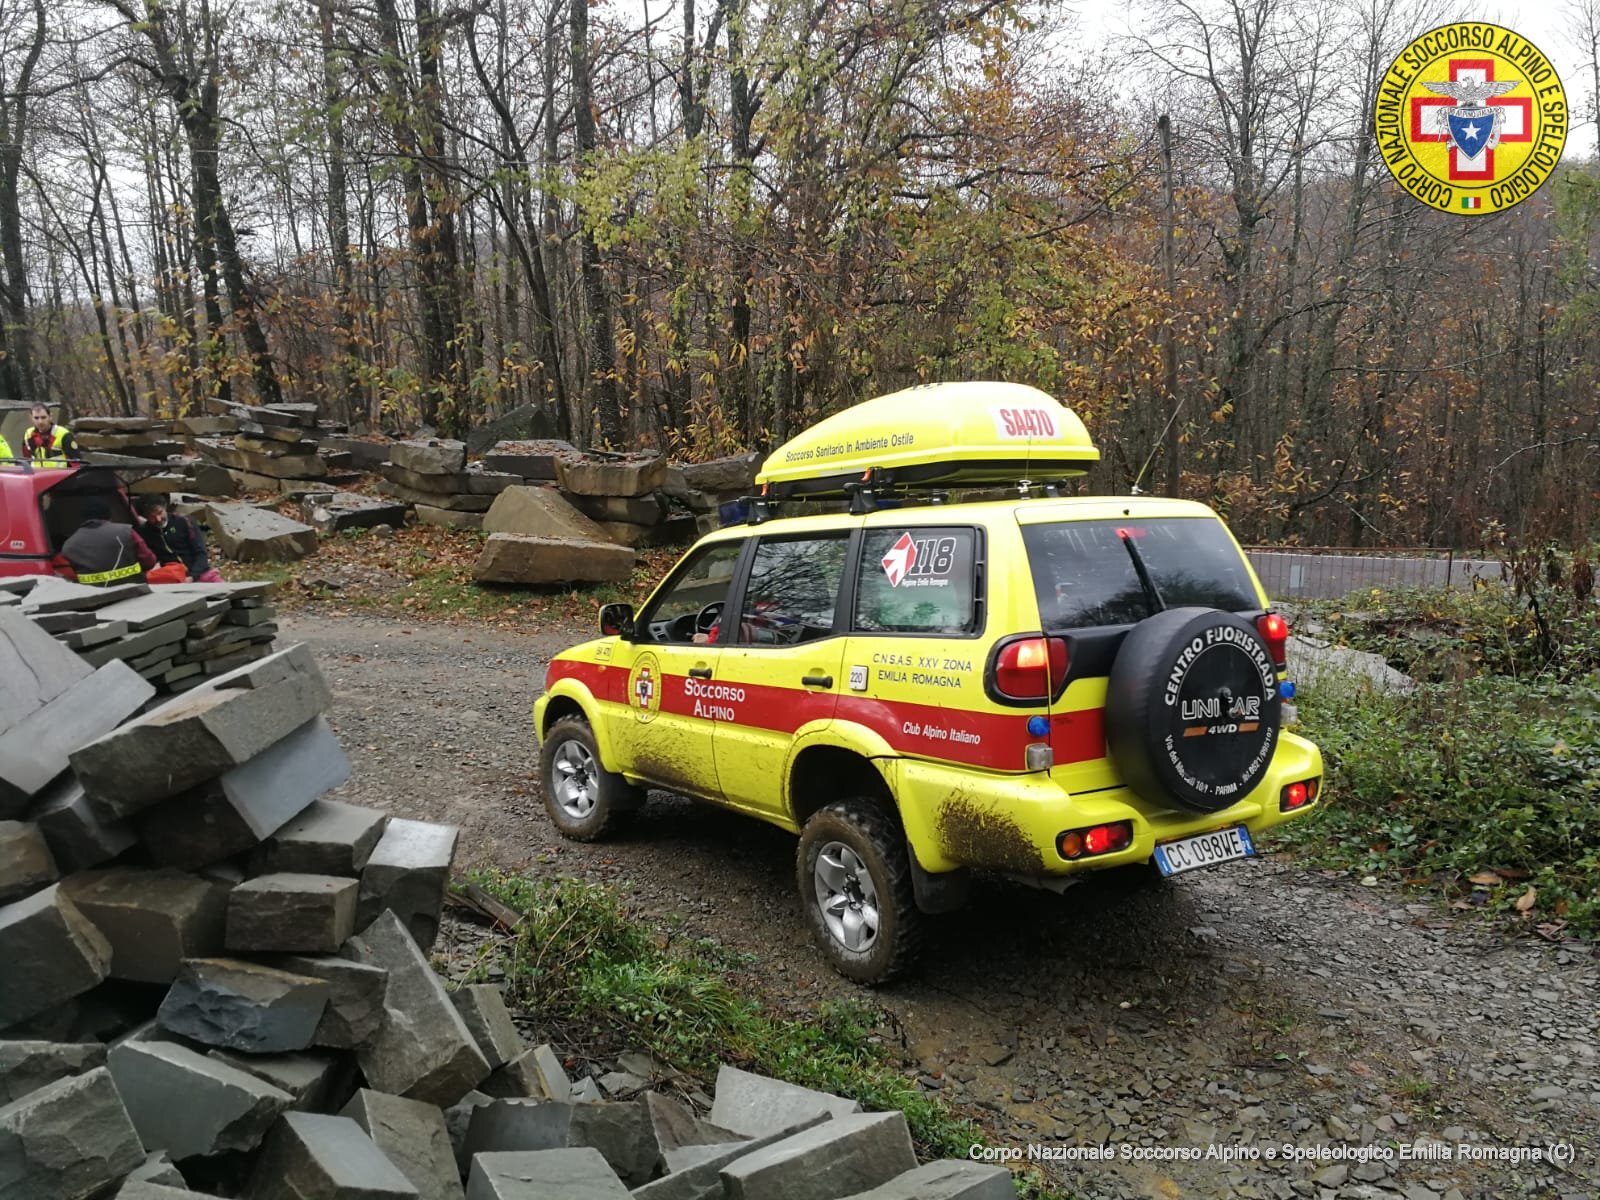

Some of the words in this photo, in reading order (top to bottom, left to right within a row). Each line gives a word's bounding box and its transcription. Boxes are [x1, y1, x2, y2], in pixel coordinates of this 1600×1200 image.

[999, 408, 1055, 437] SA470
[785, 451, 814, 462] Soccorso
[815, 443, 845, 458] Sanitario
[846, 441, 853, 453] In
[855, 437, 889, 451] Ambiente
[891, 432, 914, 447] Ostile
[908, 537, 956, 575] 118
[919, 657, 939, 668] XXV
[943, 659, 972, 672] ZONA
[1164, 636, 1204, 706] CENTRO
[1206, 626, 1275, 701] FUORISTRADA
[850, 671, 863, 684] 220
[878, 670, 908, 682] EMILIA
[912, 673, 962, 688] ROMAGNA
[903, 721, 921, 736] Club
[922, 724, 947, 740] Alpino
[949, 728, 981, 745] Italiano
[1208, 723, 1238, 735] 4WD
[1215, 782, 1238, 796] PARMA
[1166, 844, 1191, 868] CC
[1190, 831, 1242, 862] 098WE
